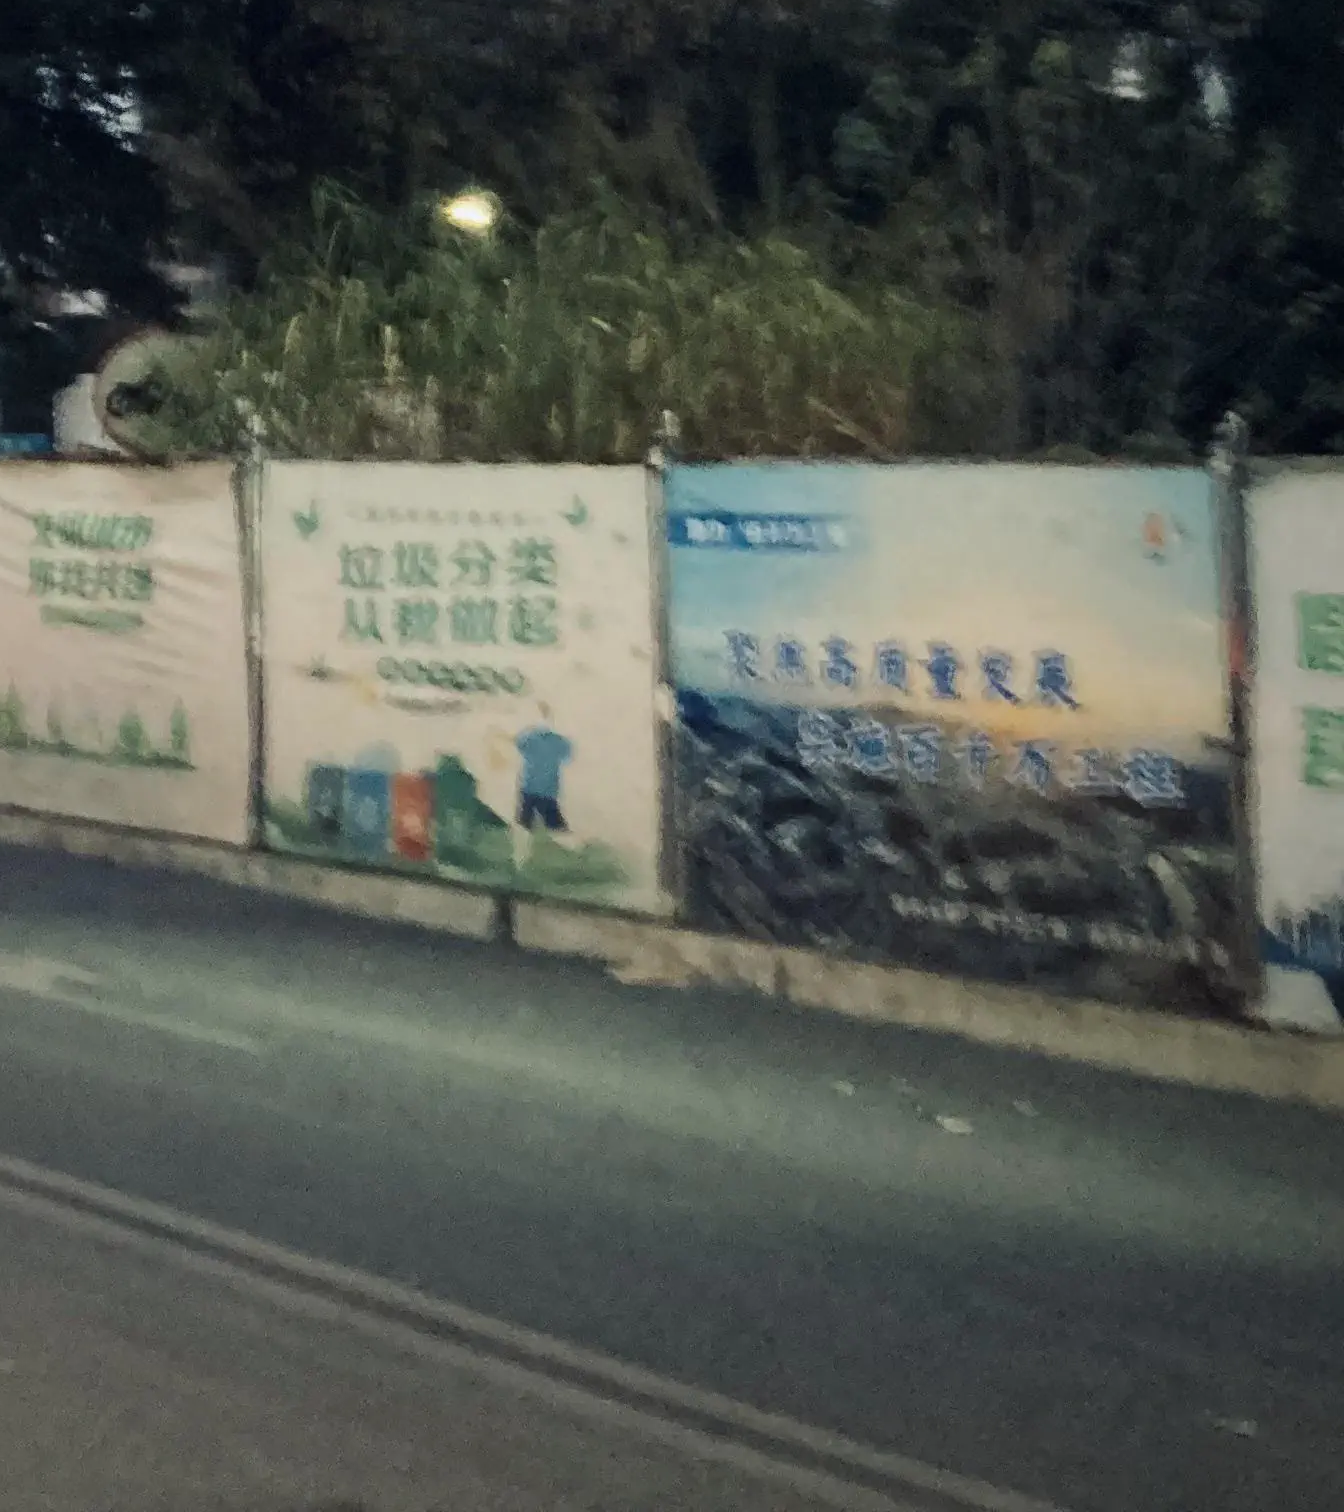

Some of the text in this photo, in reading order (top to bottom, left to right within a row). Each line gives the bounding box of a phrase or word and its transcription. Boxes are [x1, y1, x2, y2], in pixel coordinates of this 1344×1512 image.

[337, 534, 560, 591] 垃圾分类
[340, 595, 562, 646] 从我做起
